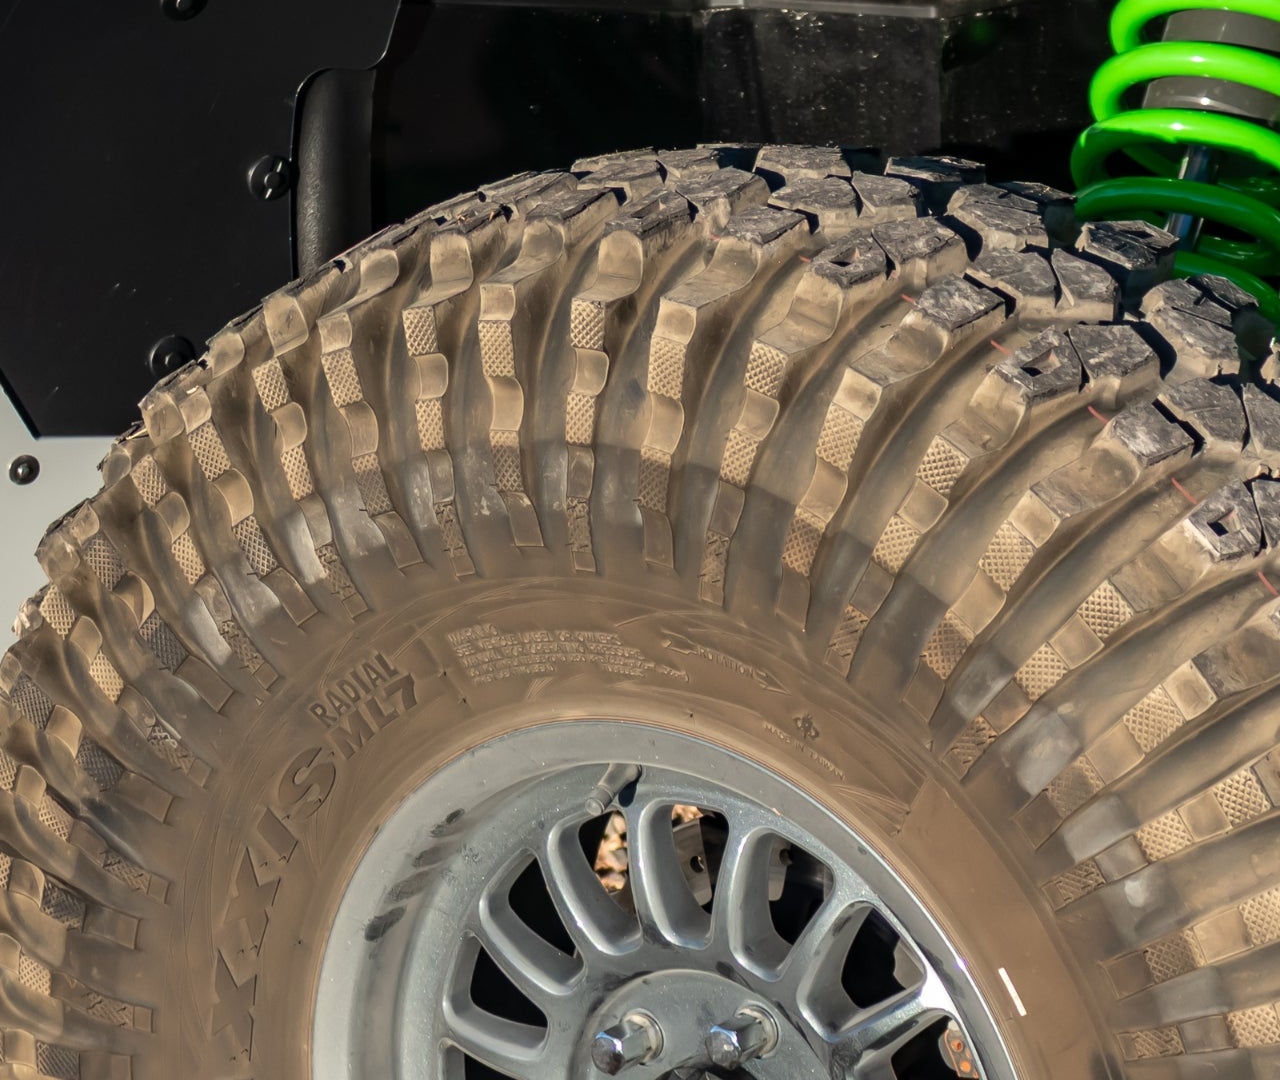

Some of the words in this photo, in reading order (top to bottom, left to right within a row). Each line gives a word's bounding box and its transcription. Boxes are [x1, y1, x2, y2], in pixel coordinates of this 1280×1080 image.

[310, 652, 401, 728] RADIAL
[697, 645, 754, 679] ROTATION
[330, 673, 419, 762] ML7
